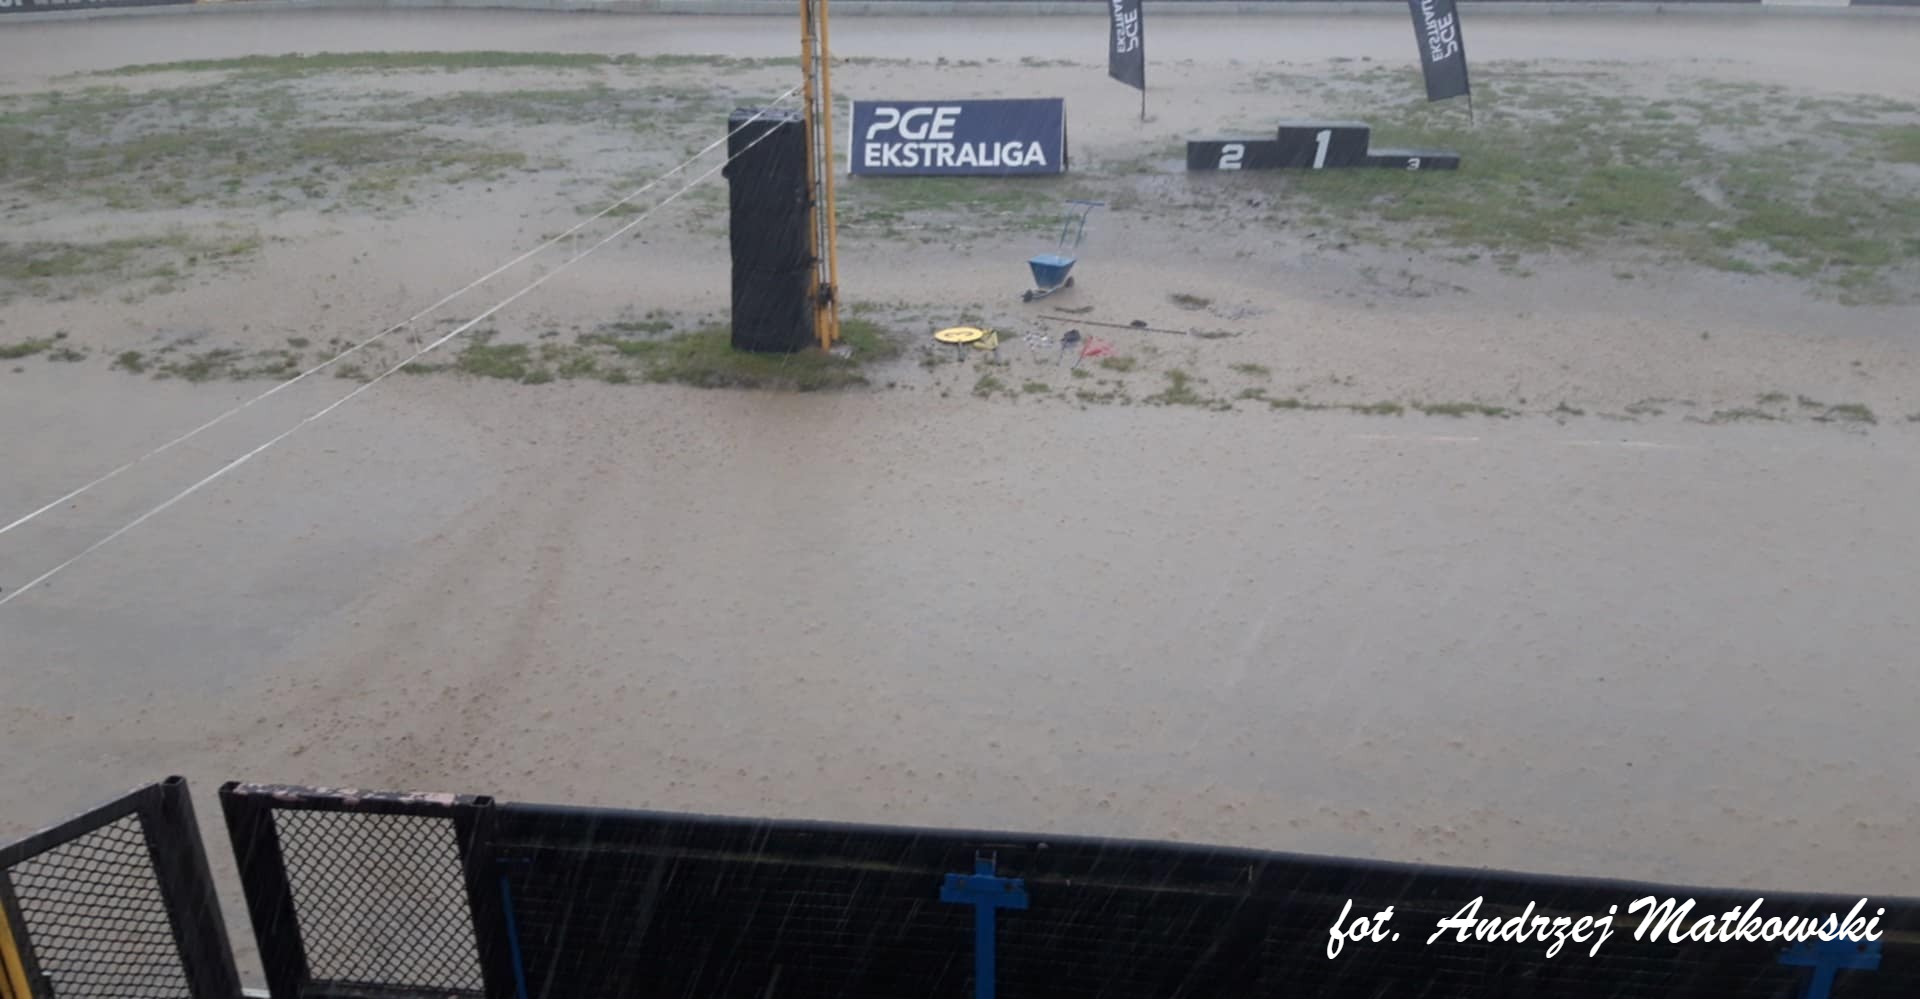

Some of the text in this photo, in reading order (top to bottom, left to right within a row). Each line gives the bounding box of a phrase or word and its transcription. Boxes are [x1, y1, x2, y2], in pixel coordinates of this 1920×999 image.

[866, 107, 962, 140] PGE
[864, 141, 1047, 167] EKSTRALIGA
[1218, 143, 1245, 169] 2
[1313, 130, 1331, 168] 1
[1407, 158, 1420, 170] 3
